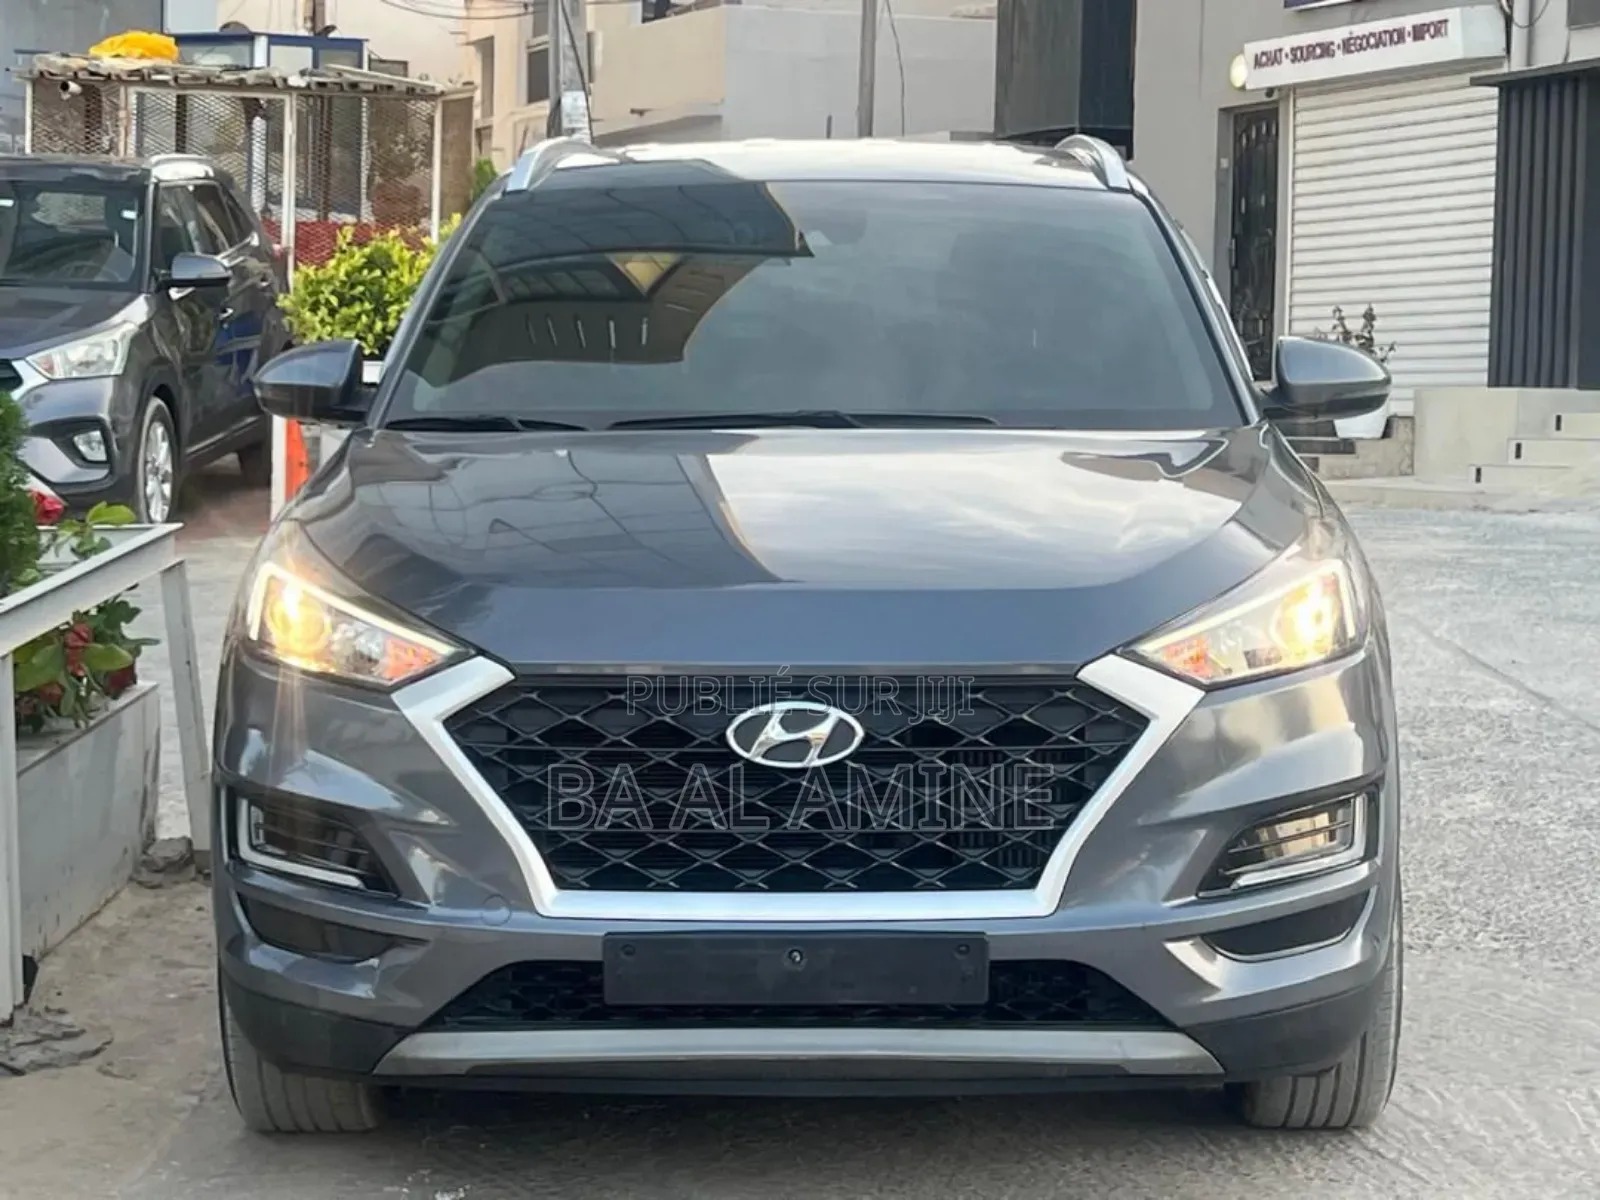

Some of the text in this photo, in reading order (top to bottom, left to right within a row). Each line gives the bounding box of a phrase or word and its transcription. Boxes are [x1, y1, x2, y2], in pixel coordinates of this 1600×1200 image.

[1254, 48, 1283, 70] ACHAT
[1290, 41, 1335, 64] SOURCING
[1341, 28, 1406, 56] NÉGOCIATION
